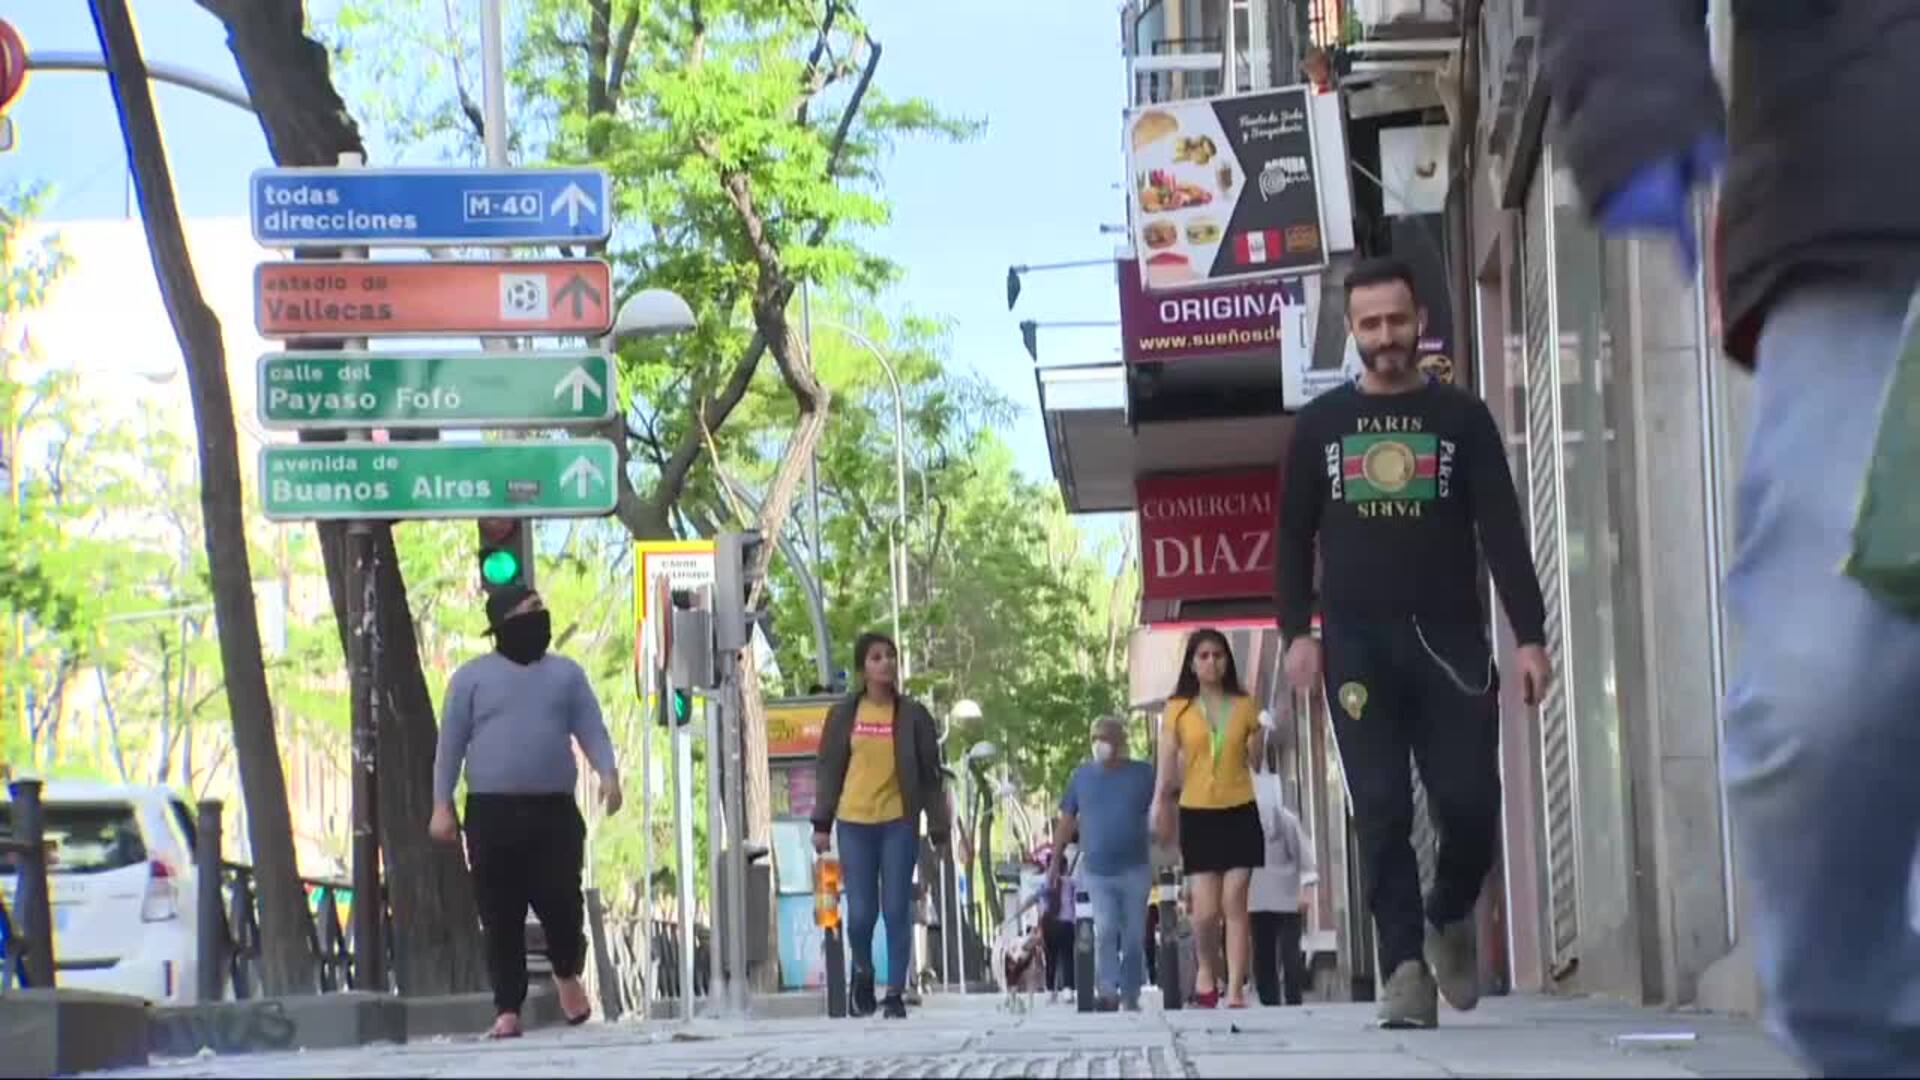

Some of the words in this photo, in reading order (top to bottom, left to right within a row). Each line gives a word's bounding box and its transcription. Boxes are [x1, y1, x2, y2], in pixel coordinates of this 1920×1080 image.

[264, 185, 340, 206] todas
[469, 196, 537, 216] M-40
[264, 209, 418, 231] direcciones
[266, 275, 347, 291] estadio
[361, 274, 387, 291] de
[267, 299, 393, 322] Vallecas
[1159, 293, 1294, 323] ORIGINA
[269, 366, 323, 382] calle
[337, 364, 371, 381] del
[268, 388, 376, 412] Payaso
[396, 385, 461, 410] Fofó
[1357, 416, 1423, 432] PARIS
[272, 456, 358, 471] avenida
[372, 455, 399, 471] de
[1325, 442, 1343, 500] PARIS
[1439, 439, 1456, 498] PARIS
[272, 479, 389, 501] Buenos
[410, 476, 492, 499] Aires
[1357, 501, 1421, 518] PARIS
[1154, 530, 1273, 577] DIAZ
